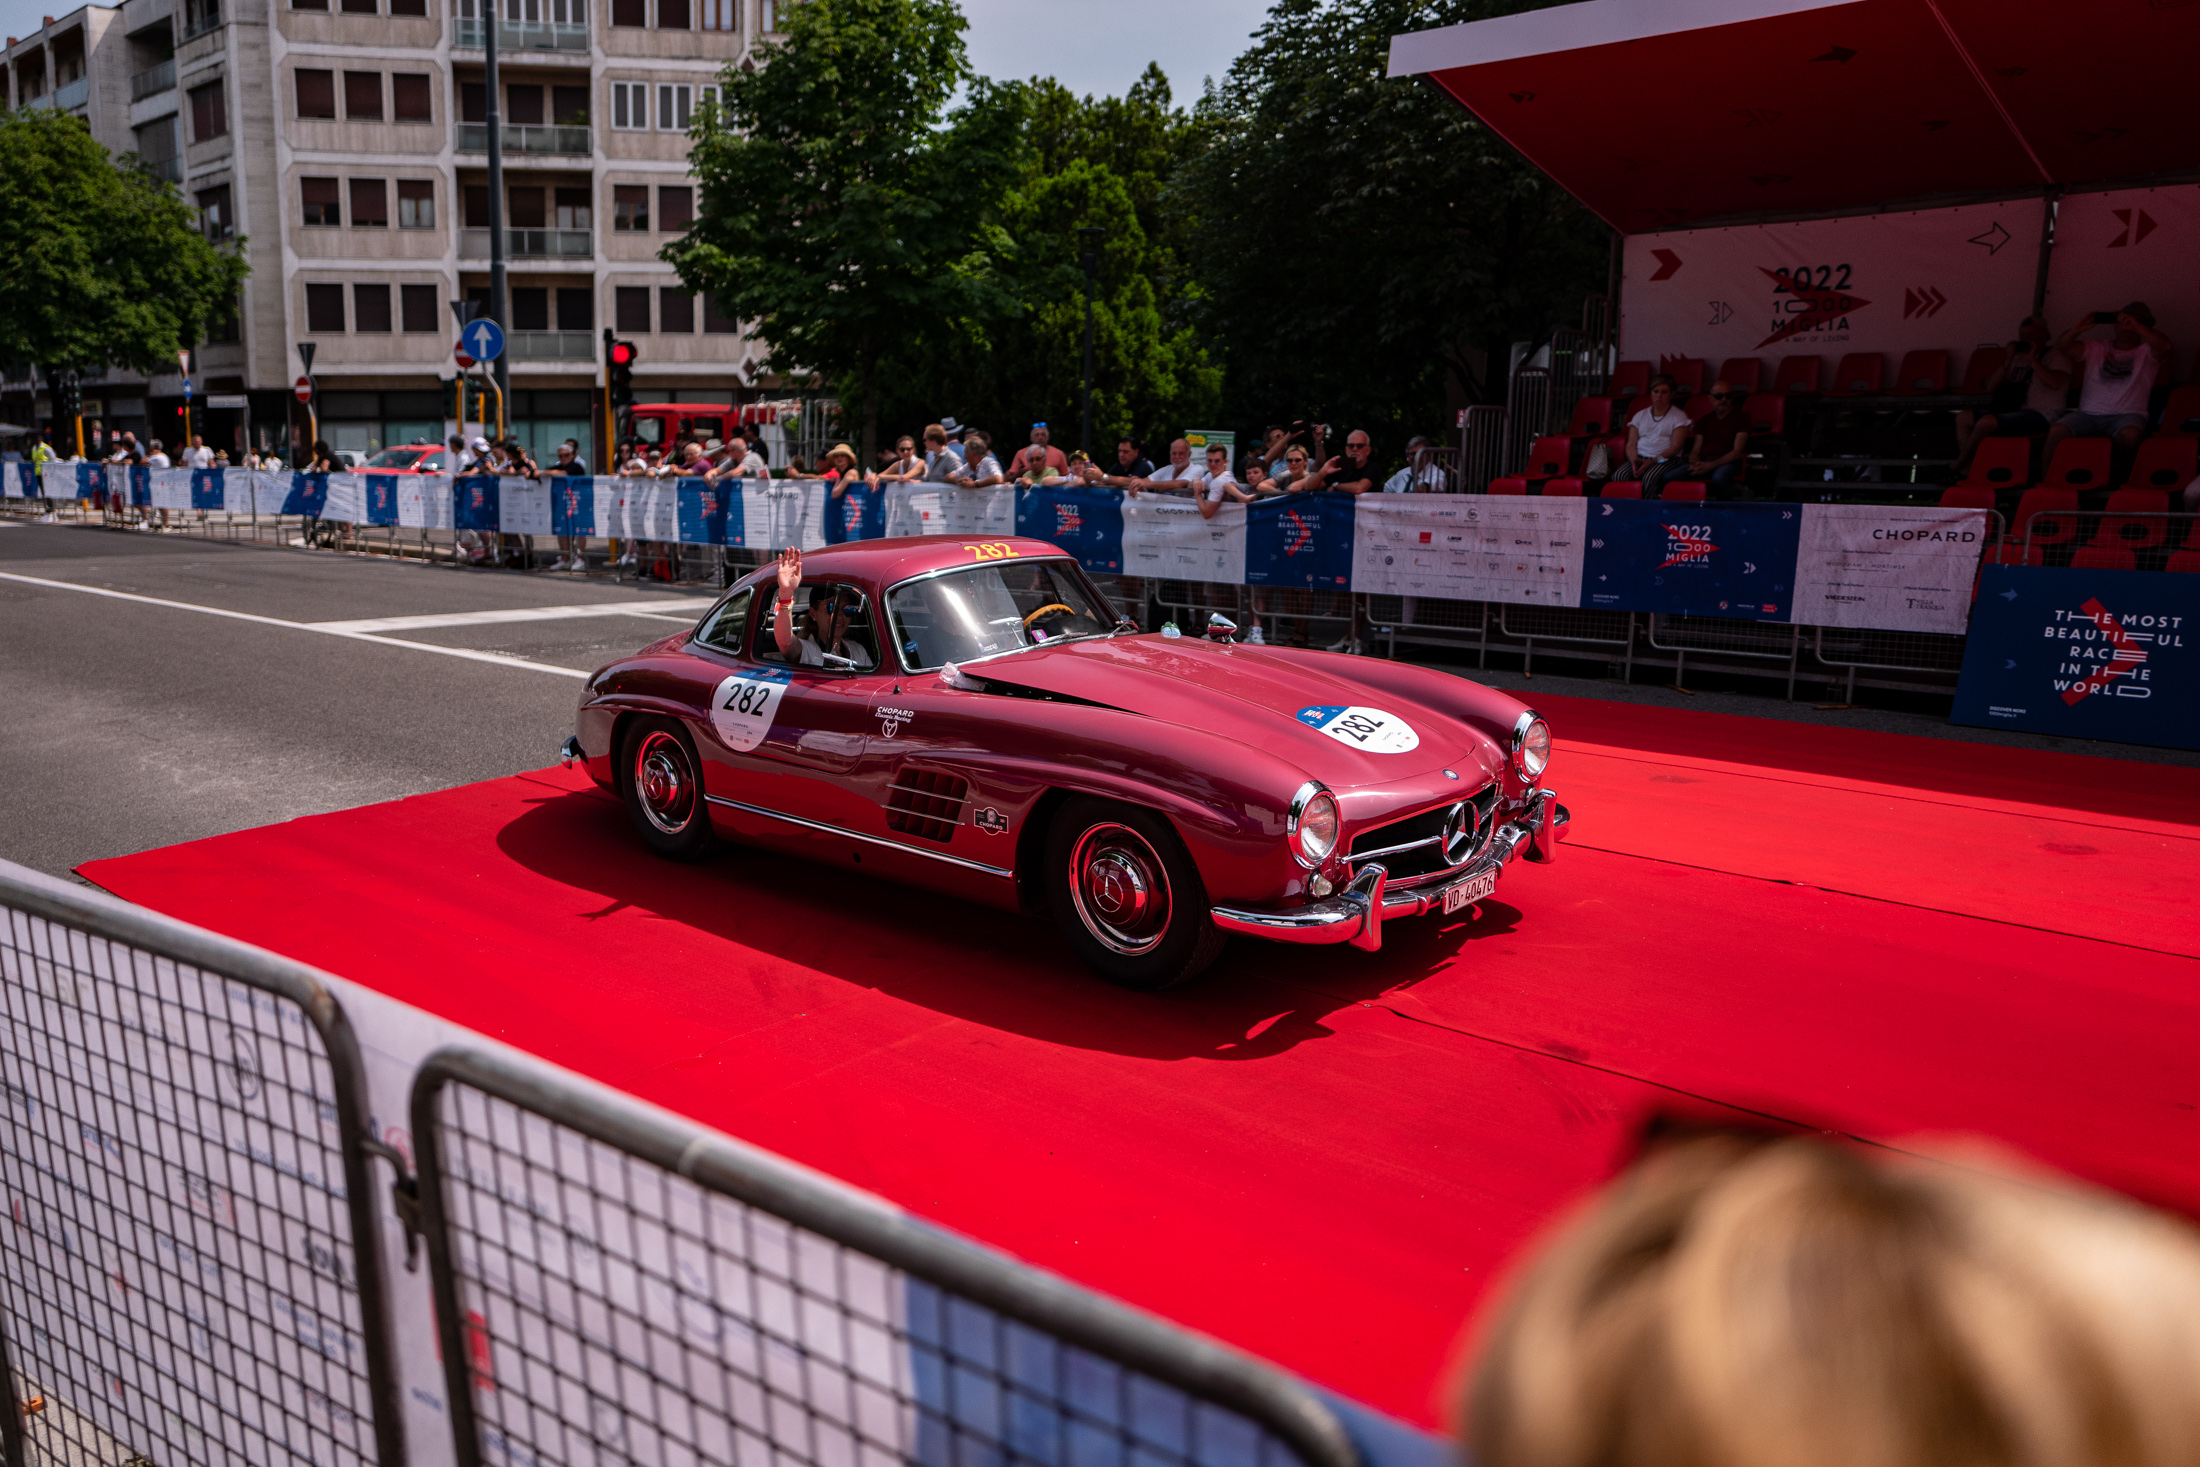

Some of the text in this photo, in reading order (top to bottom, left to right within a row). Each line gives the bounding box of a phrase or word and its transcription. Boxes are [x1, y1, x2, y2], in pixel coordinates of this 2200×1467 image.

[1773, 263, 1852, 293] 2022
[1772, 297, 1851, 313] 1000
[1771, 316, 1850, 332] MIGLIA
[1056, 504, 1079, 516] 2022
[1667, 524, 1712, 541] 2022
[1872, 529, 1976, 543] CHOPARD
[964, 542, 1020, 560] 282
[1667, 542, 1711, 552] 1000
[1666, 552, 1710, 562] MIGLIA
[2054, 610, 2183, 628] THE MOST
[2044, 626, 2184, 647] BEAUTIFUL
[2069, 646, 2149, 662] RACE
[2059, 662, 2152, 681] IN THE
[2052, 680, 2152, 698] WORLD
[722, 682, 770, 717] 282
[877, 706, 914, 718] CHOPARD
[1332, 714, 1385, 742] 282
[979, 821, 1004, 830] CHOPARD
